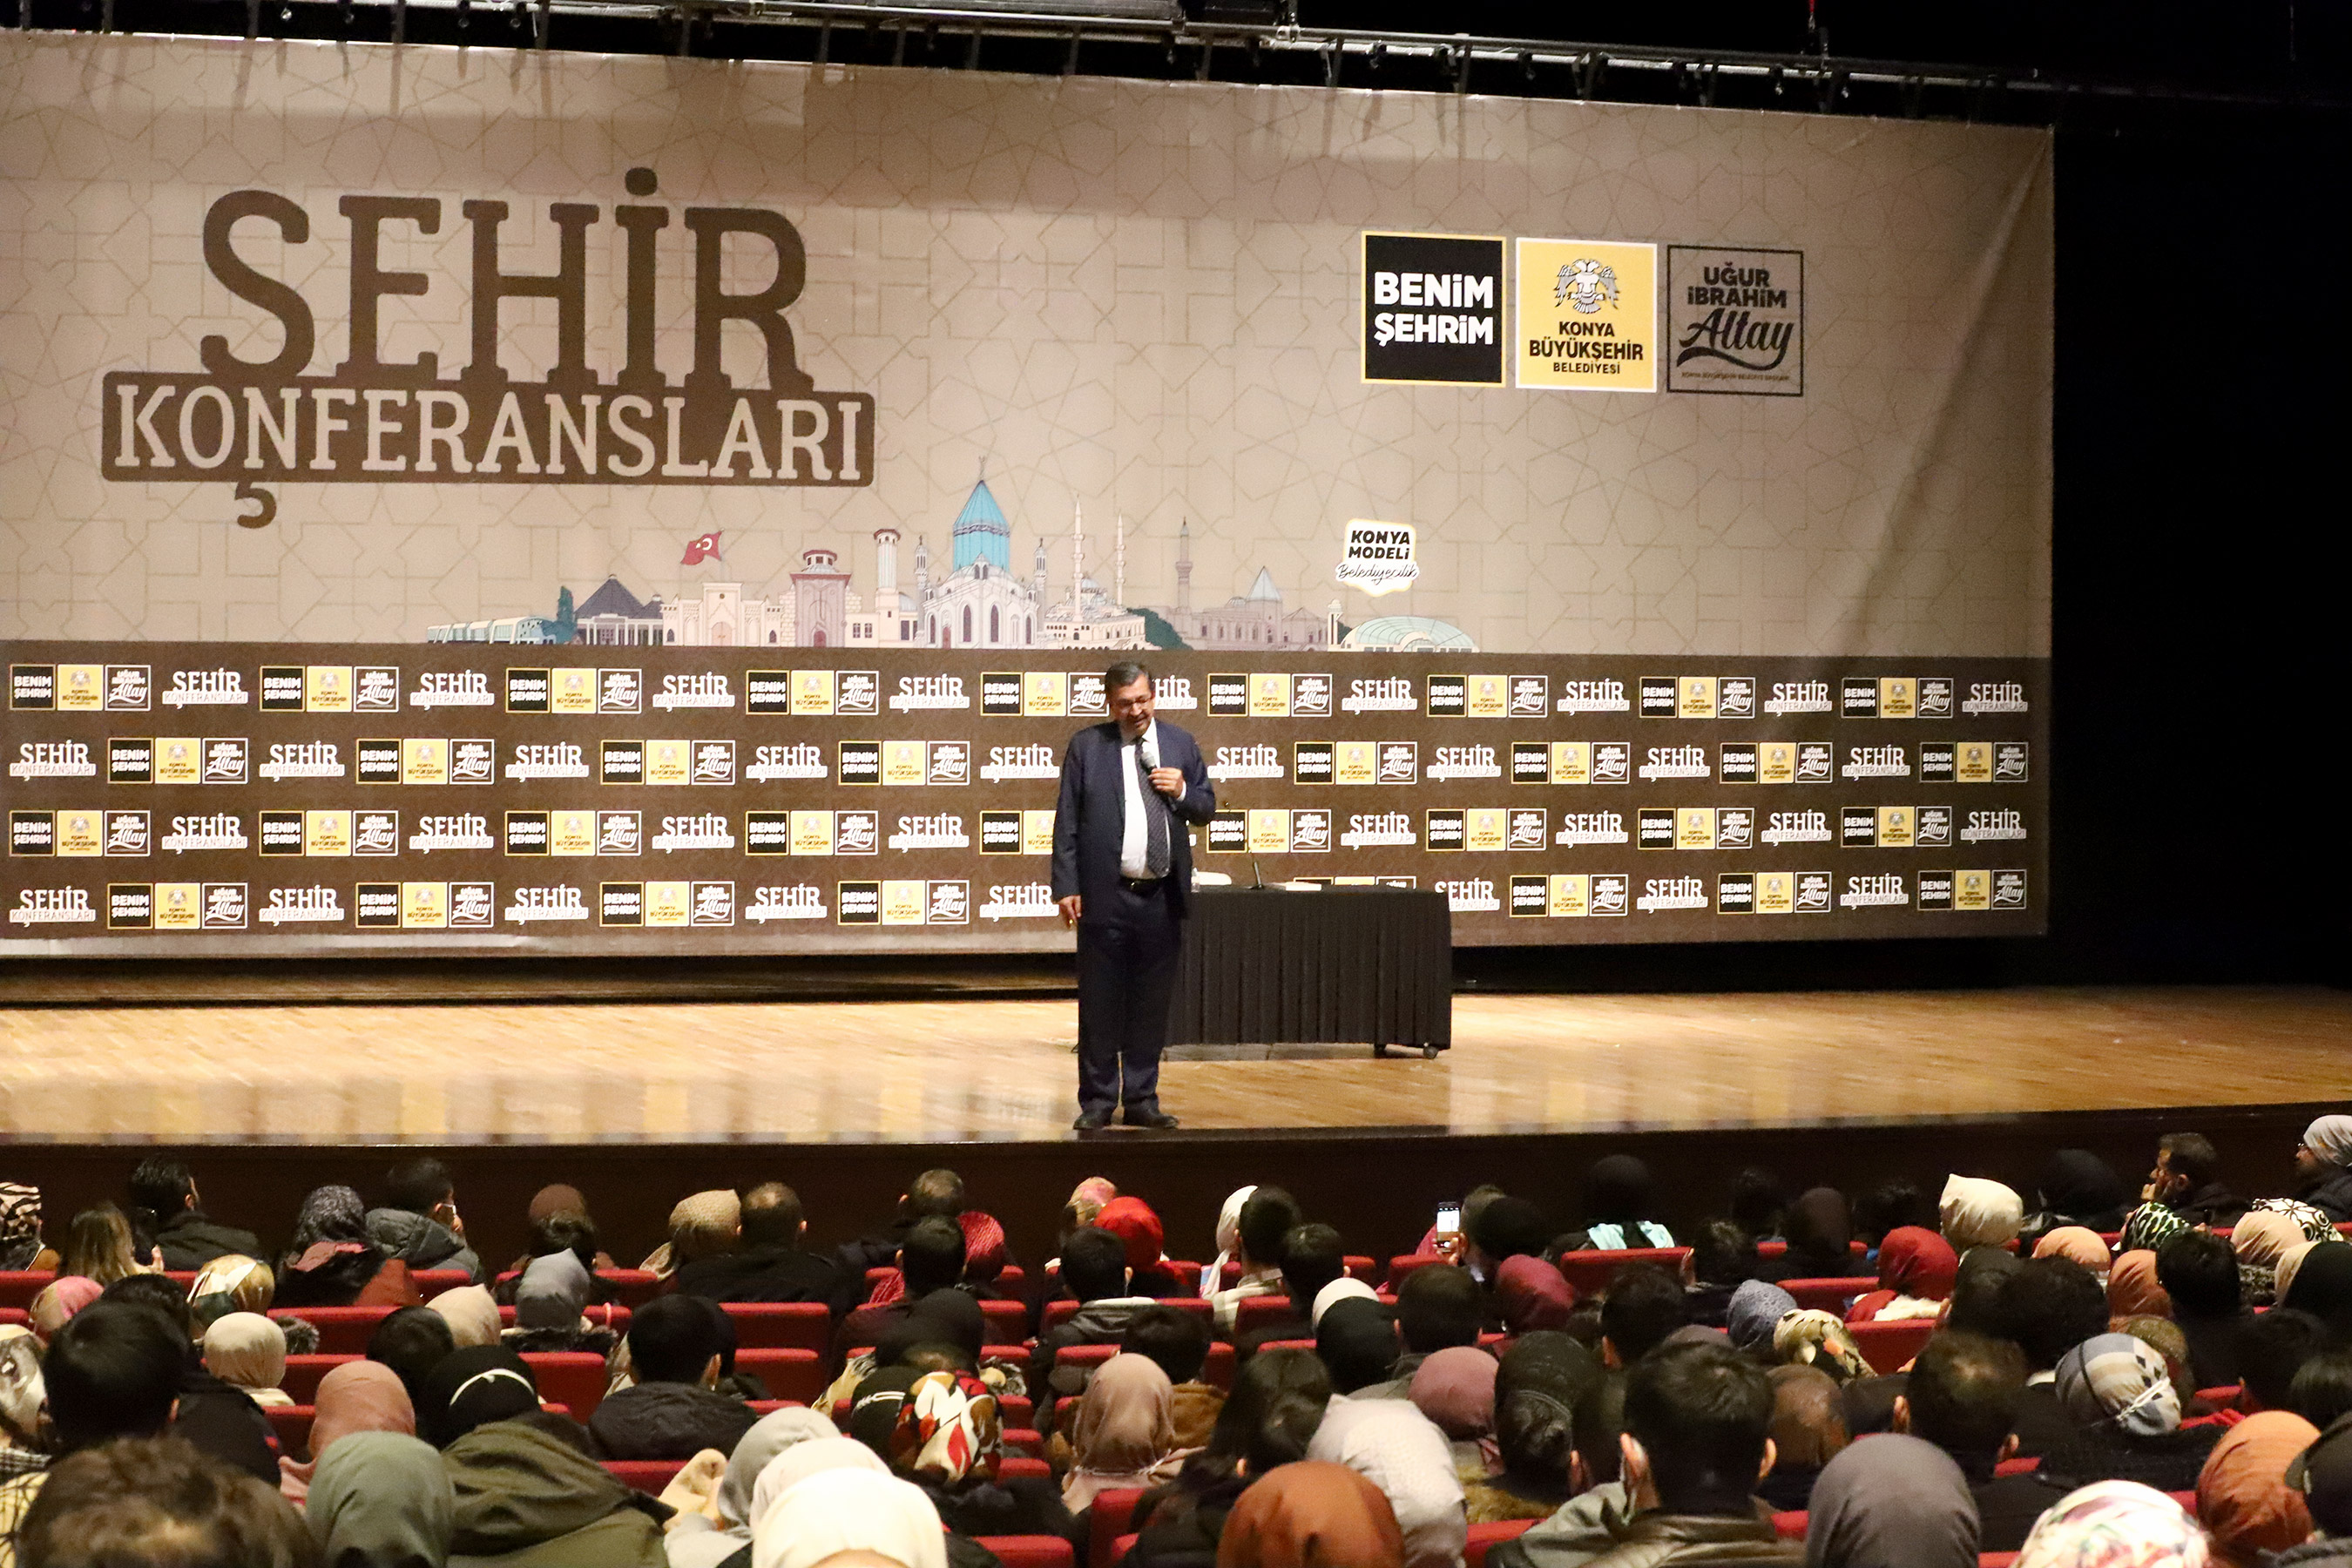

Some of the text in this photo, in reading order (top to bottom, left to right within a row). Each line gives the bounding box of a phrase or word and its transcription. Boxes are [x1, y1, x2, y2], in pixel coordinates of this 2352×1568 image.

[1704, 262, 1770, 287] UĞUR
[1558, 321, 1615, 338] KONYA
[1677, 308, 1794, 370] Altay
[1529, 336, 1644, 361] BÜYÜKŞEHİR
[1552, 360, 1620, 375] BELEDİYESİ
[113, 382, 863, 482] KONFERANSLARI
[1351, 530, 1410, 544] KONYA
[1337, 564, 1418, 585] Belediyecilik
